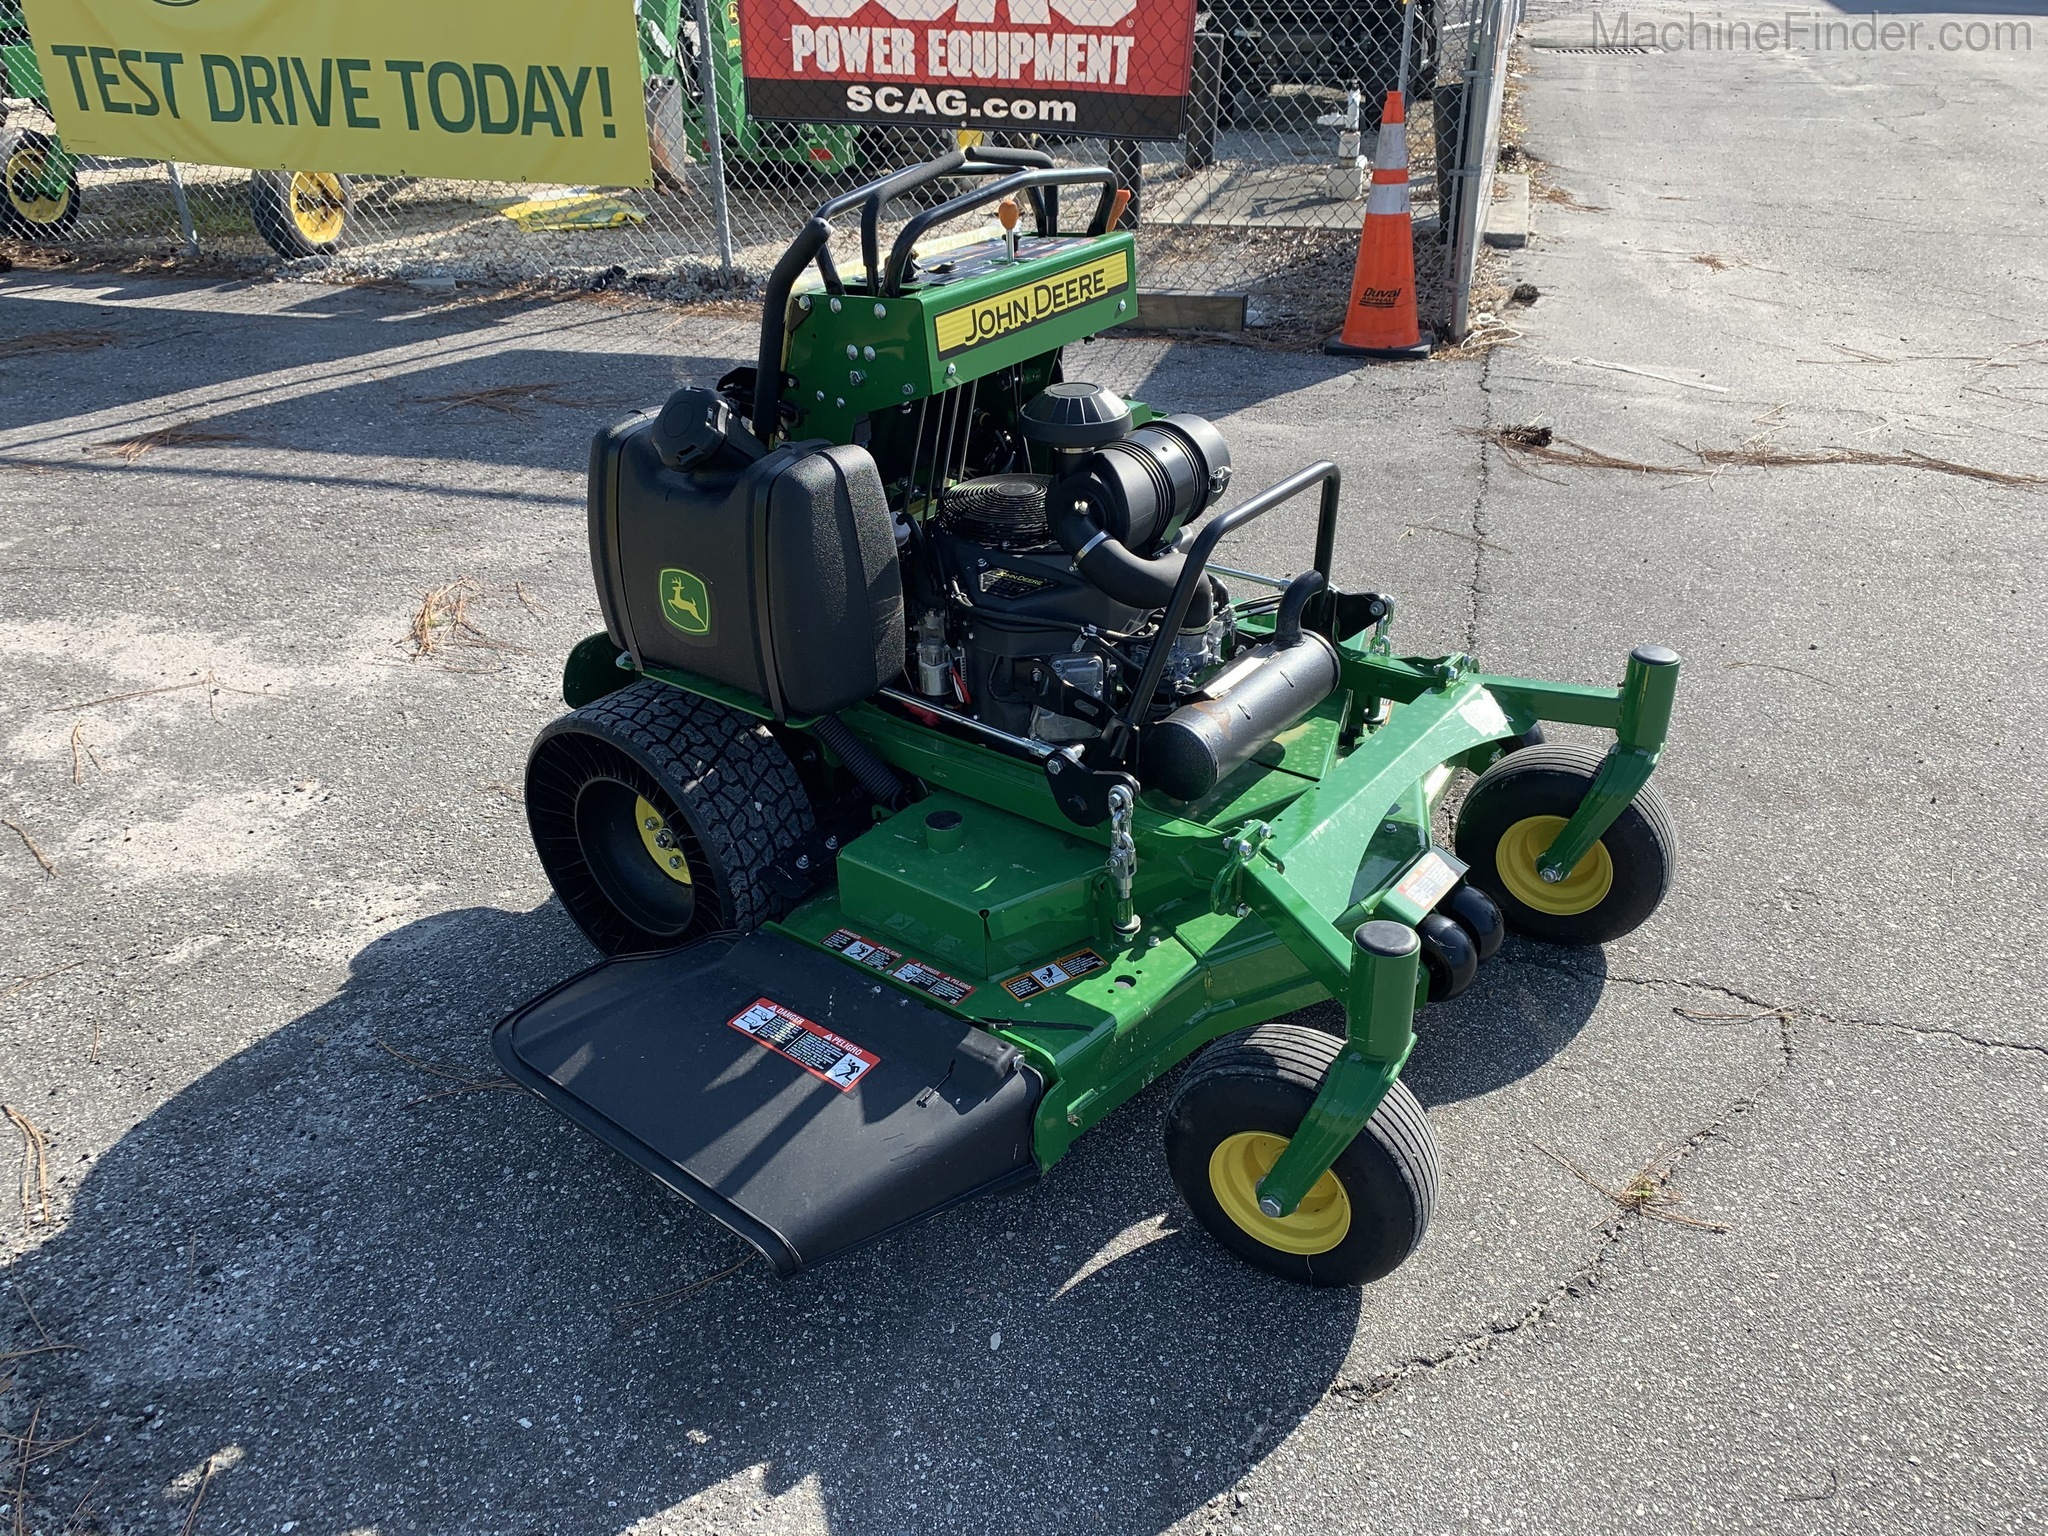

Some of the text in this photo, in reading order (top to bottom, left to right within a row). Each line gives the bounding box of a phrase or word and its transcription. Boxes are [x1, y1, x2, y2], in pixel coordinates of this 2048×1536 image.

[791, 25, 1135, 85] POWER EQUIPMENT
[52, 45, 616, 138] TEST DRIVE TODAY!
[846, 85, 1077, 122] SCAG.com
[965, 269, 1106, 342] JOHN DEERE
[1363, 287, 1402, 297] Duval
[776, 1007, 805, 1025] DANGER
[832, 1036, 863, 1057] PELIGRO
